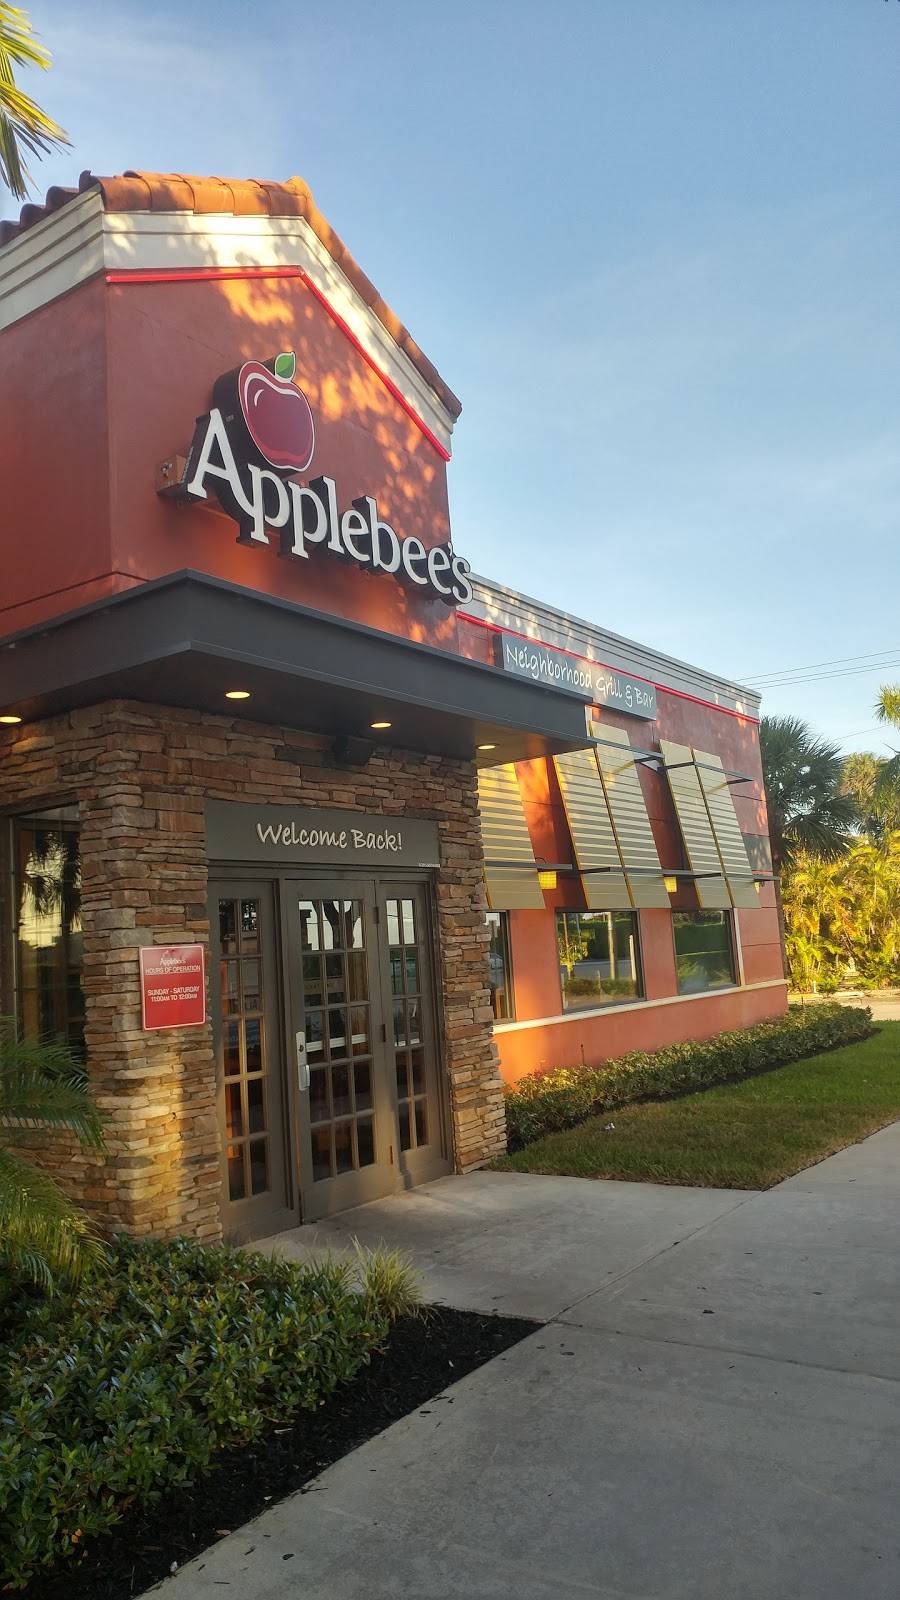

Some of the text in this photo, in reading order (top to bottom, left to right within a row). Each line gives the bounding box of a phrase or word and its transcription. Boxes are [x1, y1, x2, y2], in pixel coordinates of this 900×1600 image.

[187, 407, 474, 605] Applebee's
[506, 643, 654, 708] Neighborhood Grill & Bar
[256, 821, 403, 851] Welcome Back!
[165, 966, 172, 974] OF
[172, 965, 200, 973] OPERATION
[147, 988, 169, 996] SUNDAY
[173, 986, 200, 994] SATURDAY
